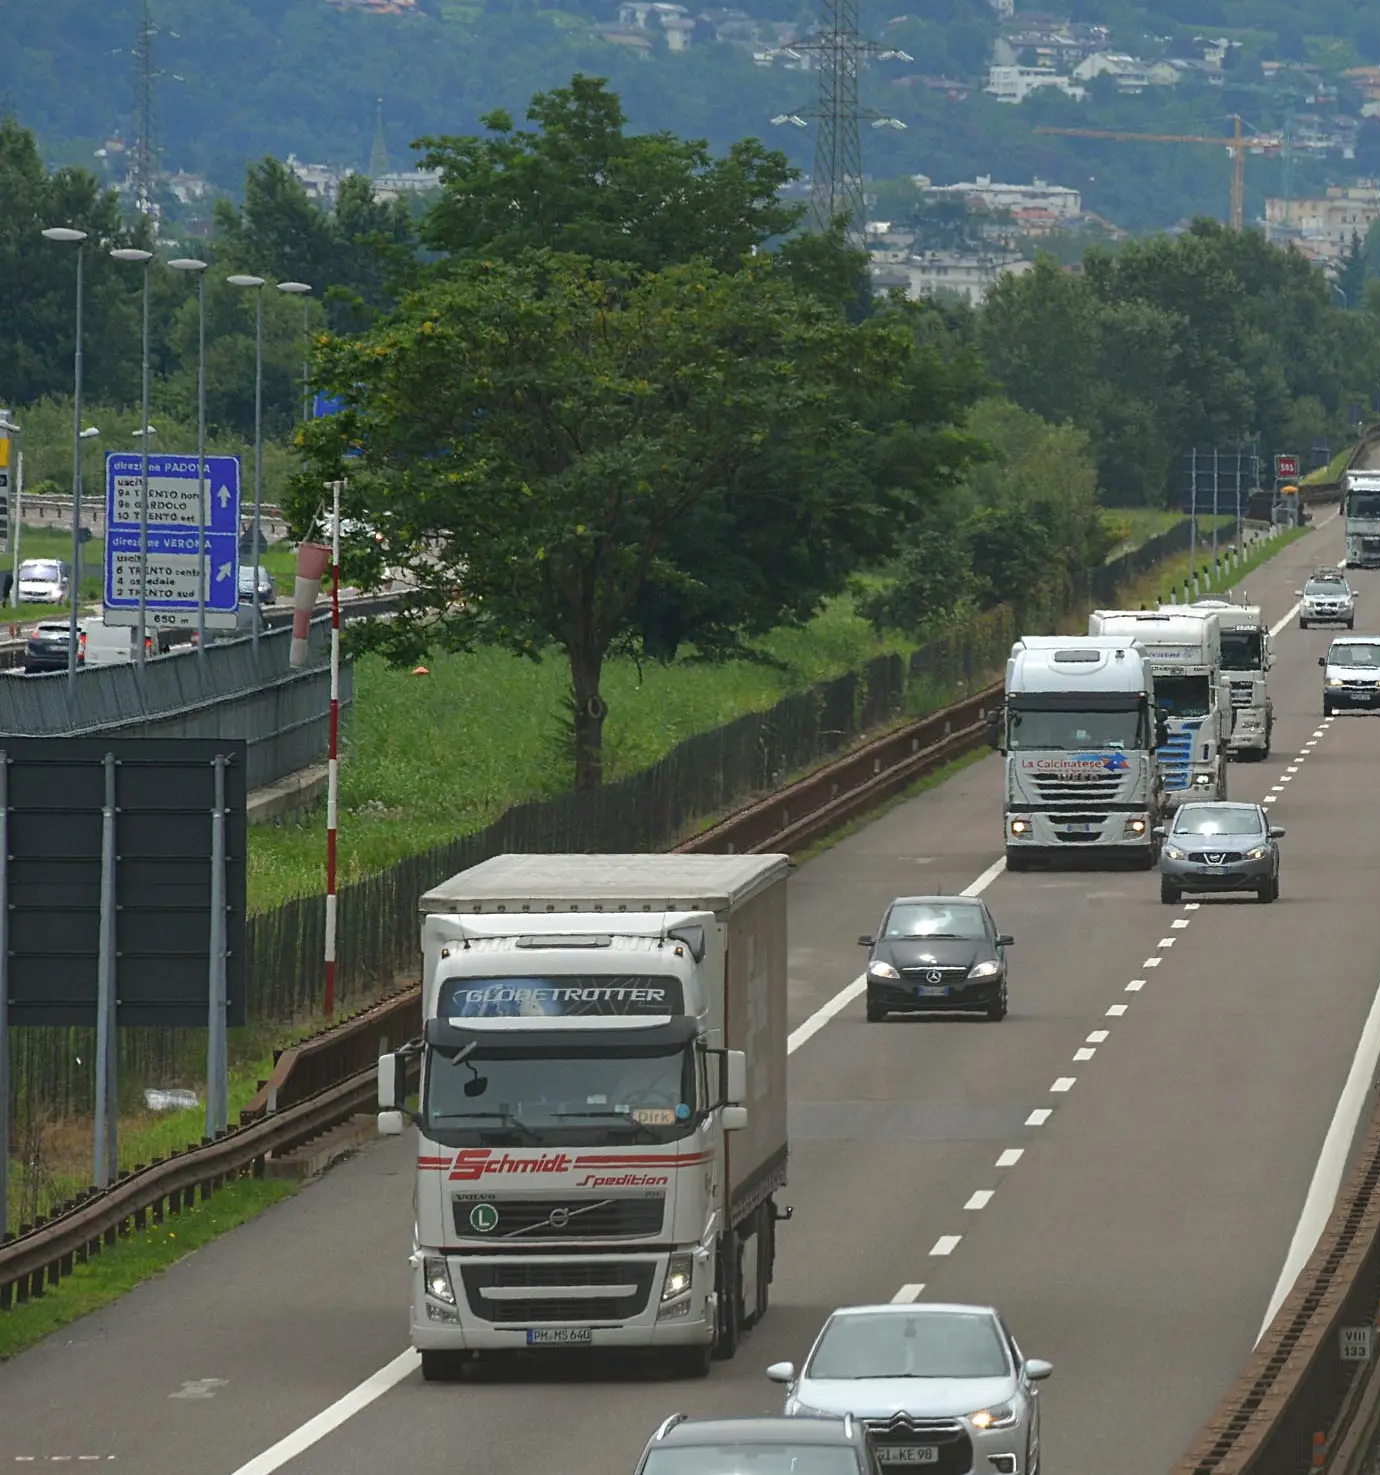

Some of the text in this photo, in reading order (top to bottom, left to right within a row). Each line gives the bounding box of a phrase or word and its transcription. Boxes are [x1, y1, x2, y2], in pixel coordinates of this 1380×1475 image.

[114, 461, 160, 471] direzine
[135, 489, 178, 499] TENTO
[134, 512, 177, 521] TENTO
[112, 537, 160, 547] direzine
[116, 566, 123, 574] 6
[130, 577, 176, 586] osedale
[177, 590, 195, 598] sud
[154, 615, 176, 624] 650
[1022, 760, 1100, 768] La Calcinatese
[465, 987, 666, 1002] GLOBETROTTER
[638, 1111, 669, 1121] Dirk
[449, 1150, 573, 1181] Schmidt
[576, 1174, 669, 1188] Spedition
[478, 1210, 490, 1227] L
[1346, 1331, 1365, 1341] VIII
[1345, 1346, 1366, 1357] 133
[918, 1447, 932, 1460] 98
